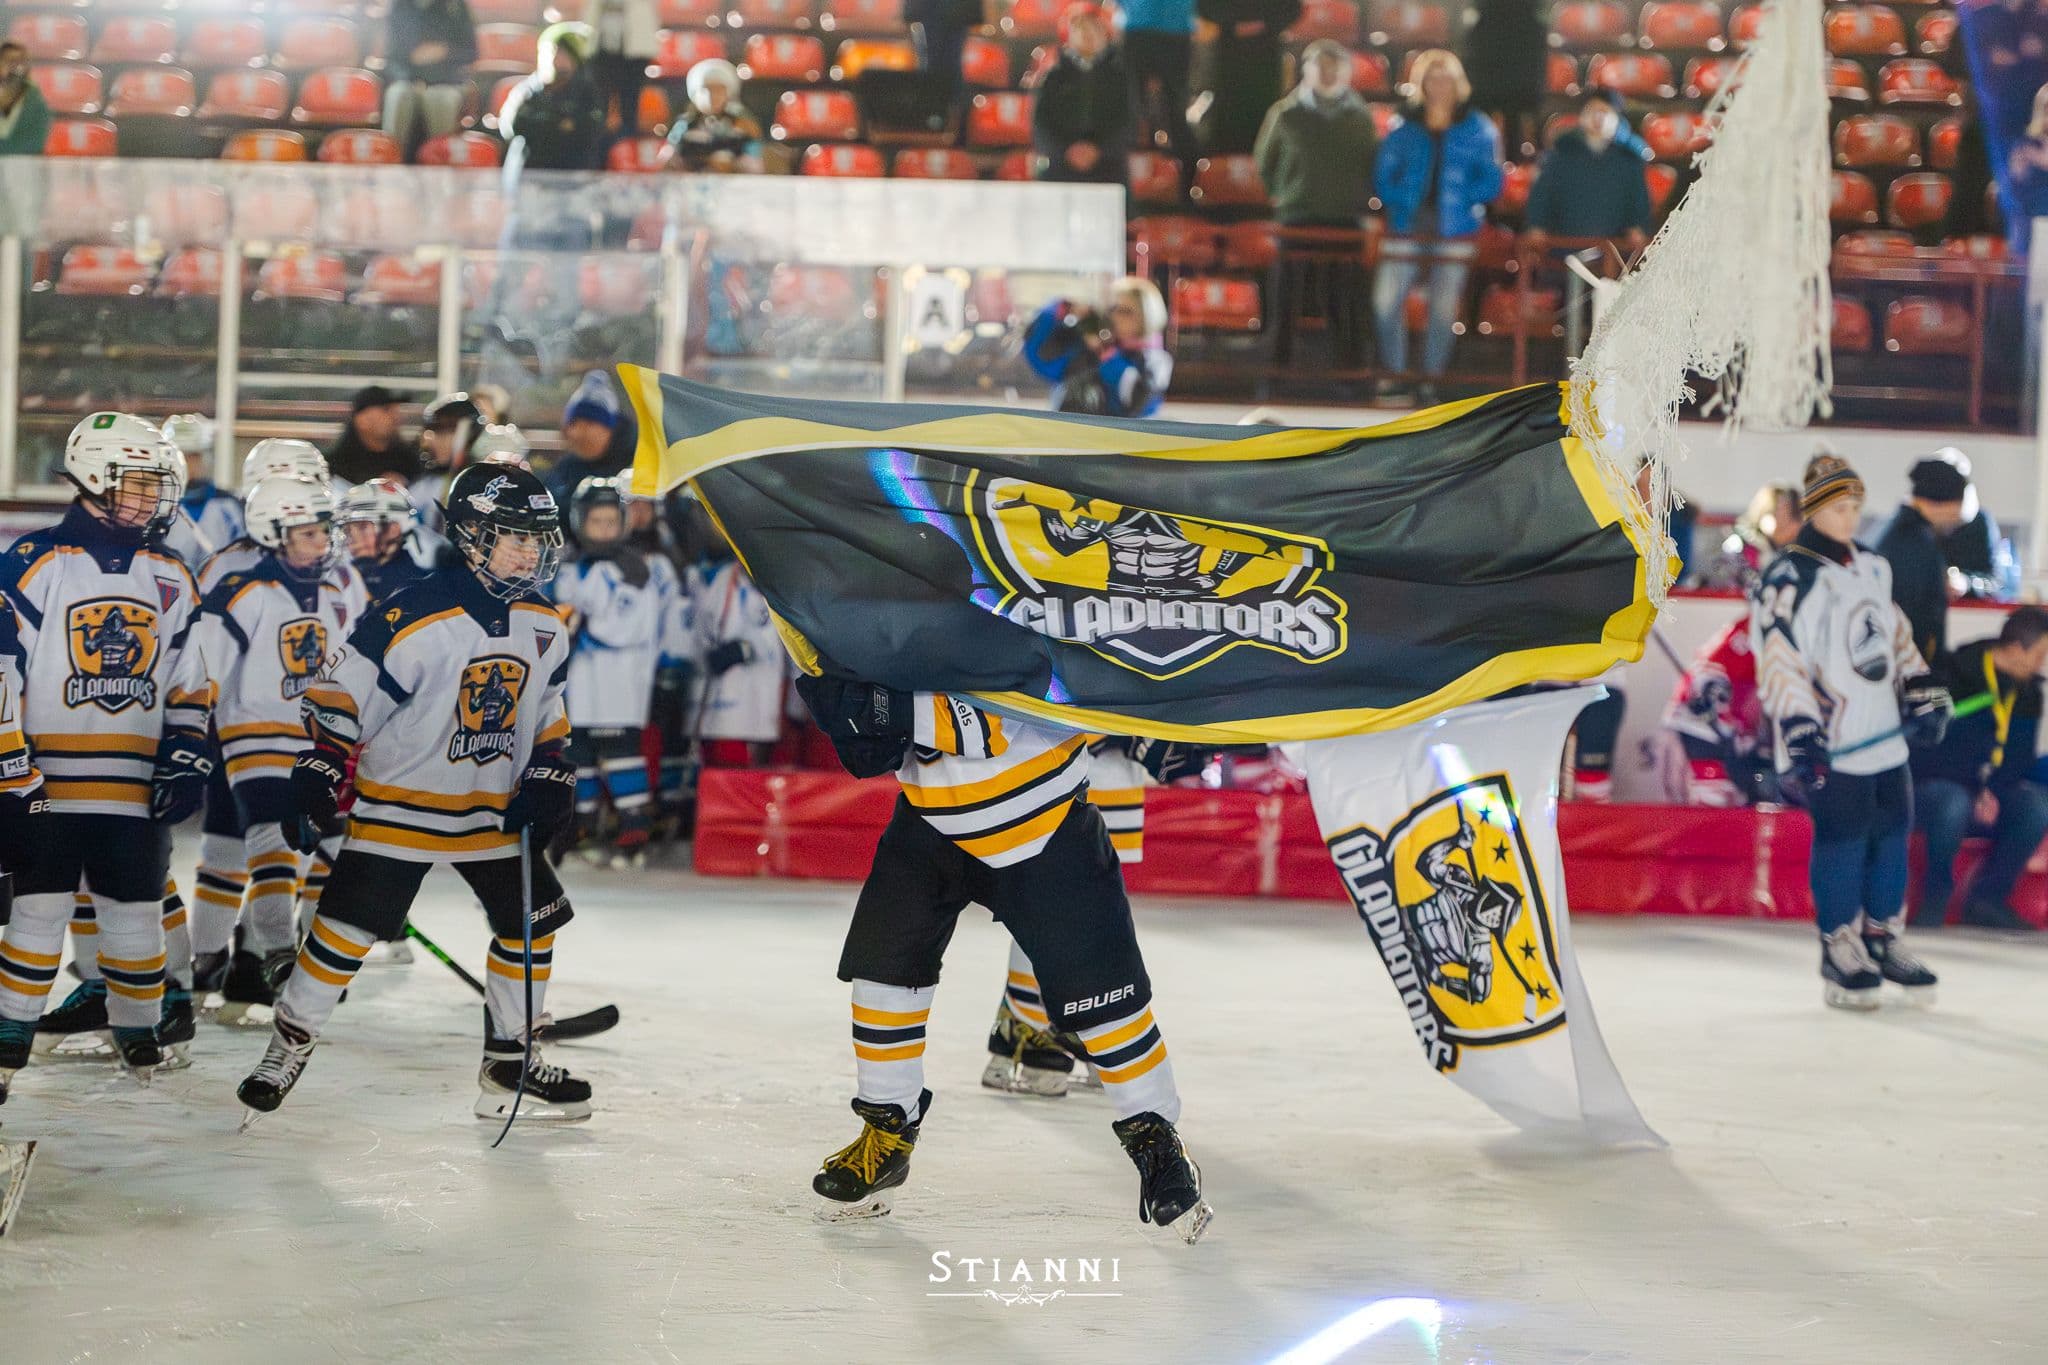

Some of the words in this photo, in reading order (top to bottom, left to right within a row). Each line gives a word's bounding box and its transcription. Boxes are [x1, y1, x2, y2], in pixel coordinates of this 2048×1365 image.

[1008, 595, 1336, 657] GLADIATORS
[66, 677, 155, 708] GLADIATORS
[1331, 833, 1454, 1068] GLADIATORS
[1063, 983, 1135, 1016] BAUER
